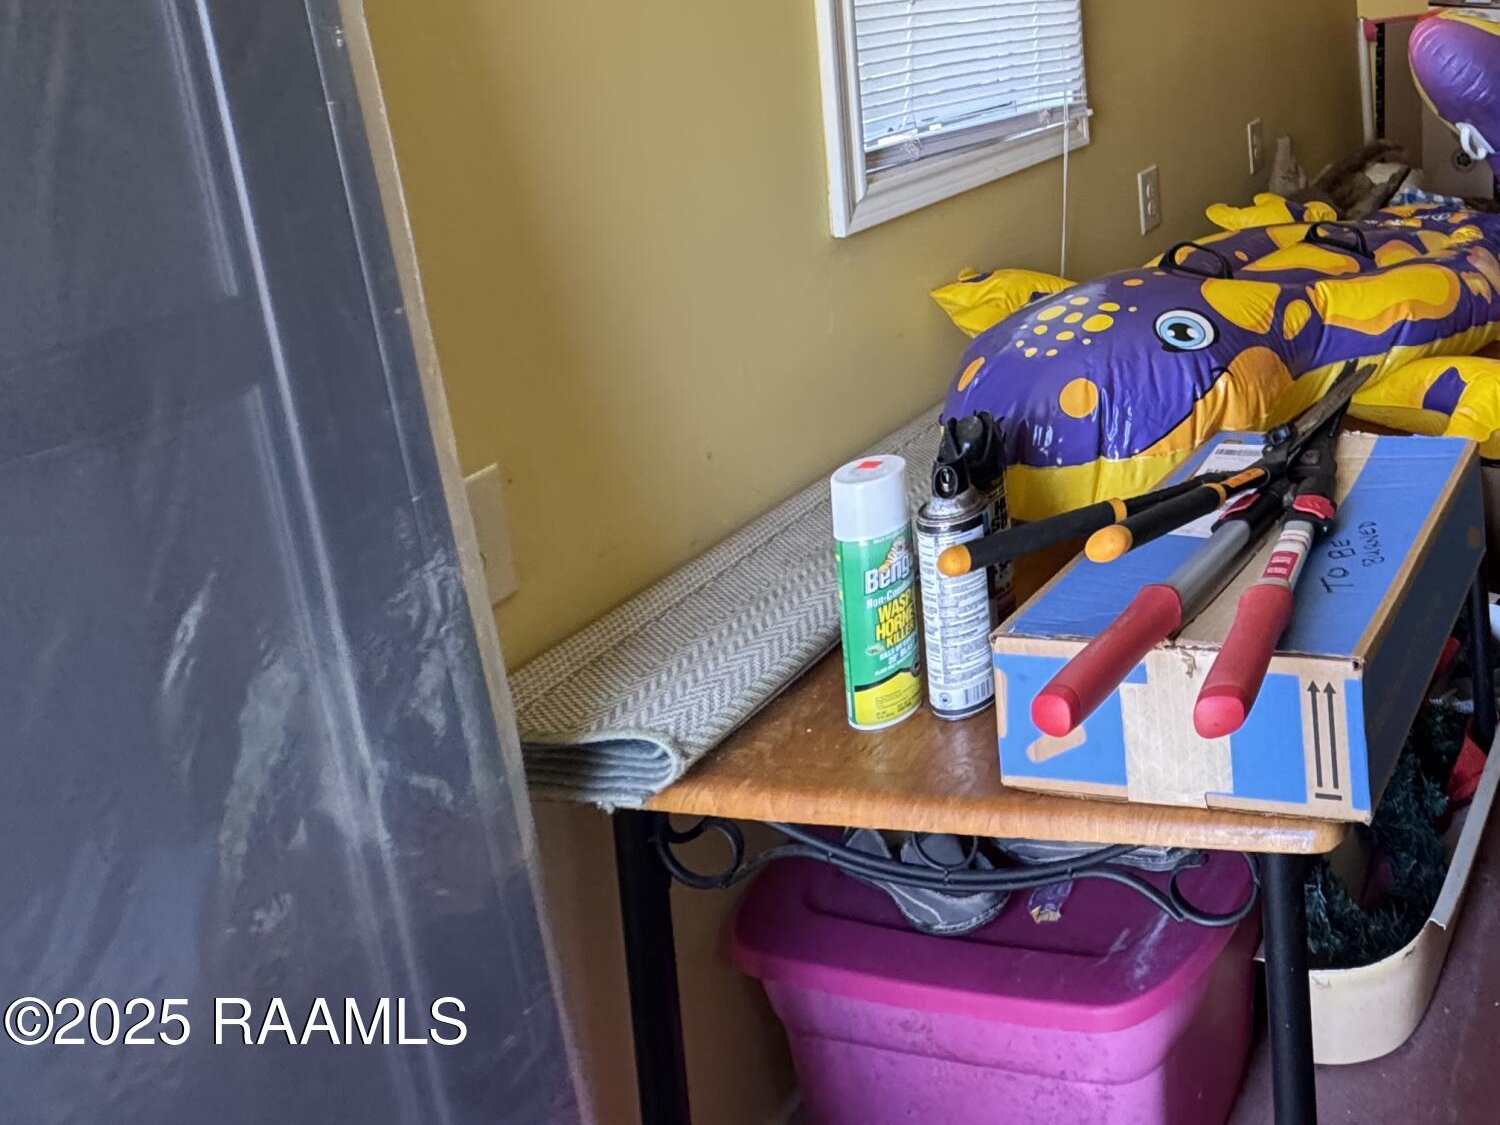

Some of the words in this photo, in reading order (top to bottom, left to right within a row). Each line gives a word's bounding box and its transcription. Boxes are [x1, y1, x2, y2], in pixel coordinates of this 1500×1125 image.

[1328, 539, 1357, 559] BE
[1358, 521, 1385, 567] BURNED
[1319, 567, 1355, 593] TO
[877, 589, 912, 623] WASP
